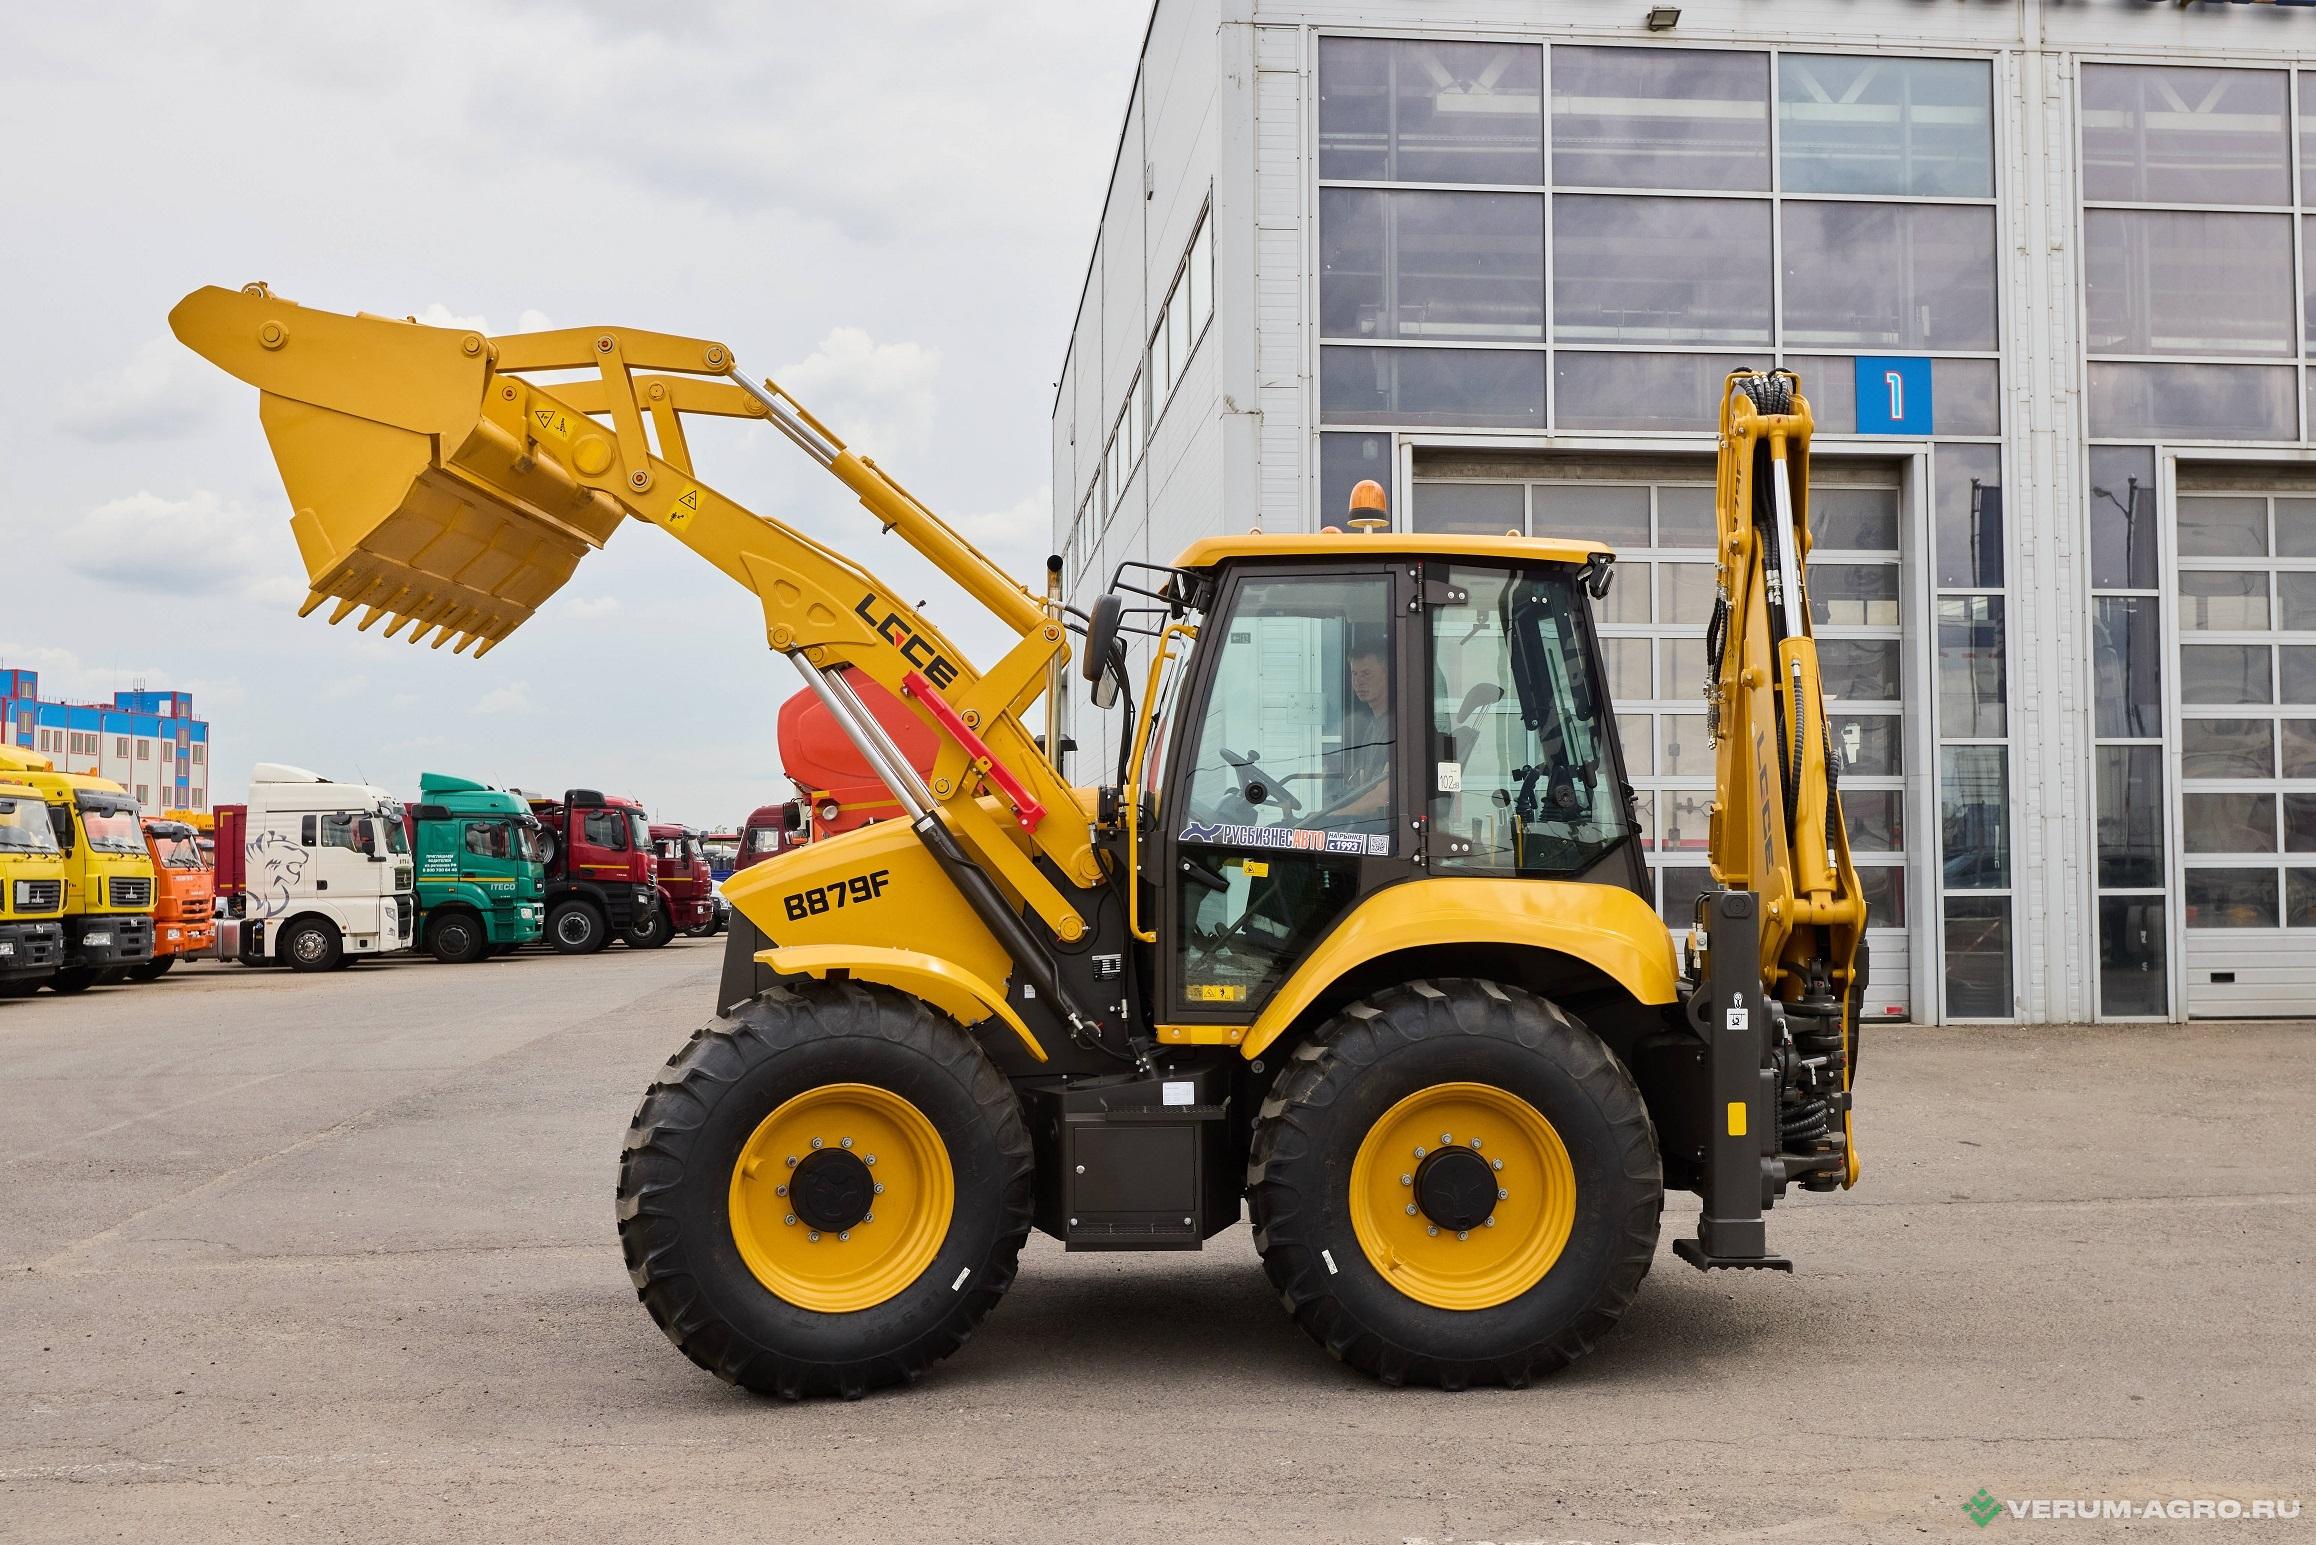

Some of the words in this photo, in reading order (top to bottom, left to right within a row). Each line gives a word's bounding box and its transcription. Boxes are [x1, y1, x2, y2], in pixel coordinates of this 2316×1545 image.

[1885, 370, 1904, 421] 1
[855, 593, 959, 690] LGCE
[1223, 825, 1326, 850] РУСБИЗНЕСАВТО
[1336, 841, 1358, 851] 1993
[784, 869, 889, 921] B879F
